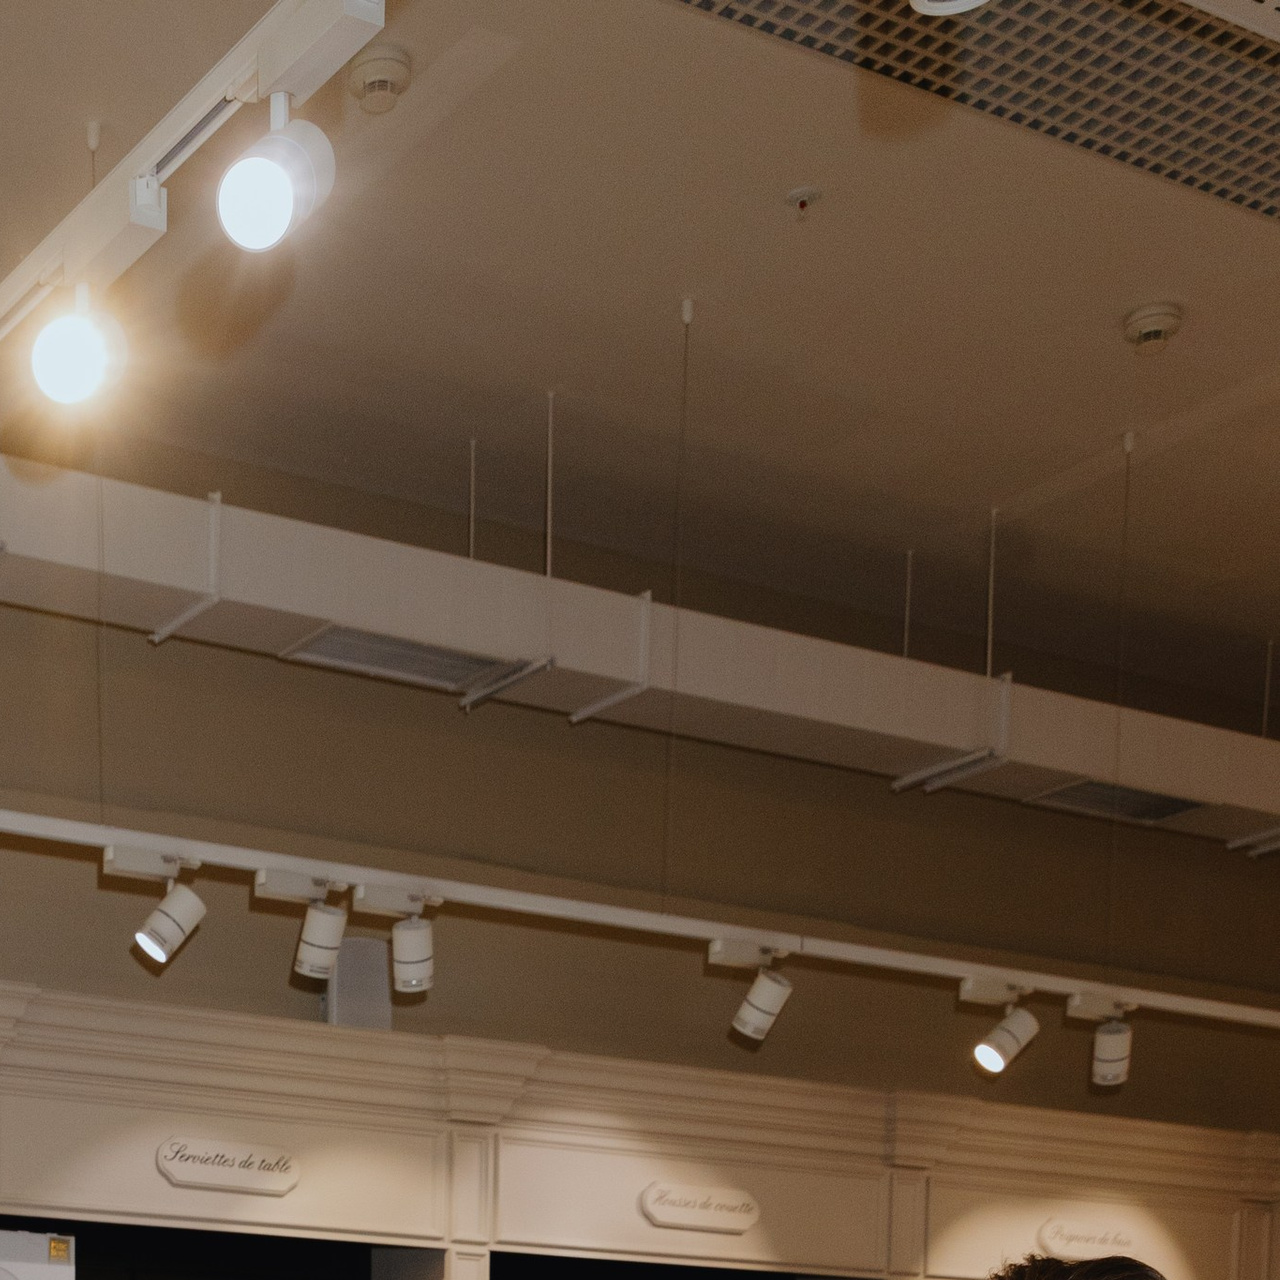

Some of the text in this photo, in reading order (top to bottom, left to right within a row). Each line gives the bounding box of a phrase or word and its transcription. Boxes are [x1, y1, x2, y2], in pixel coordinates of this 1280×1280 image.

[164, 1142, 291, 1173] Serviettes de table
